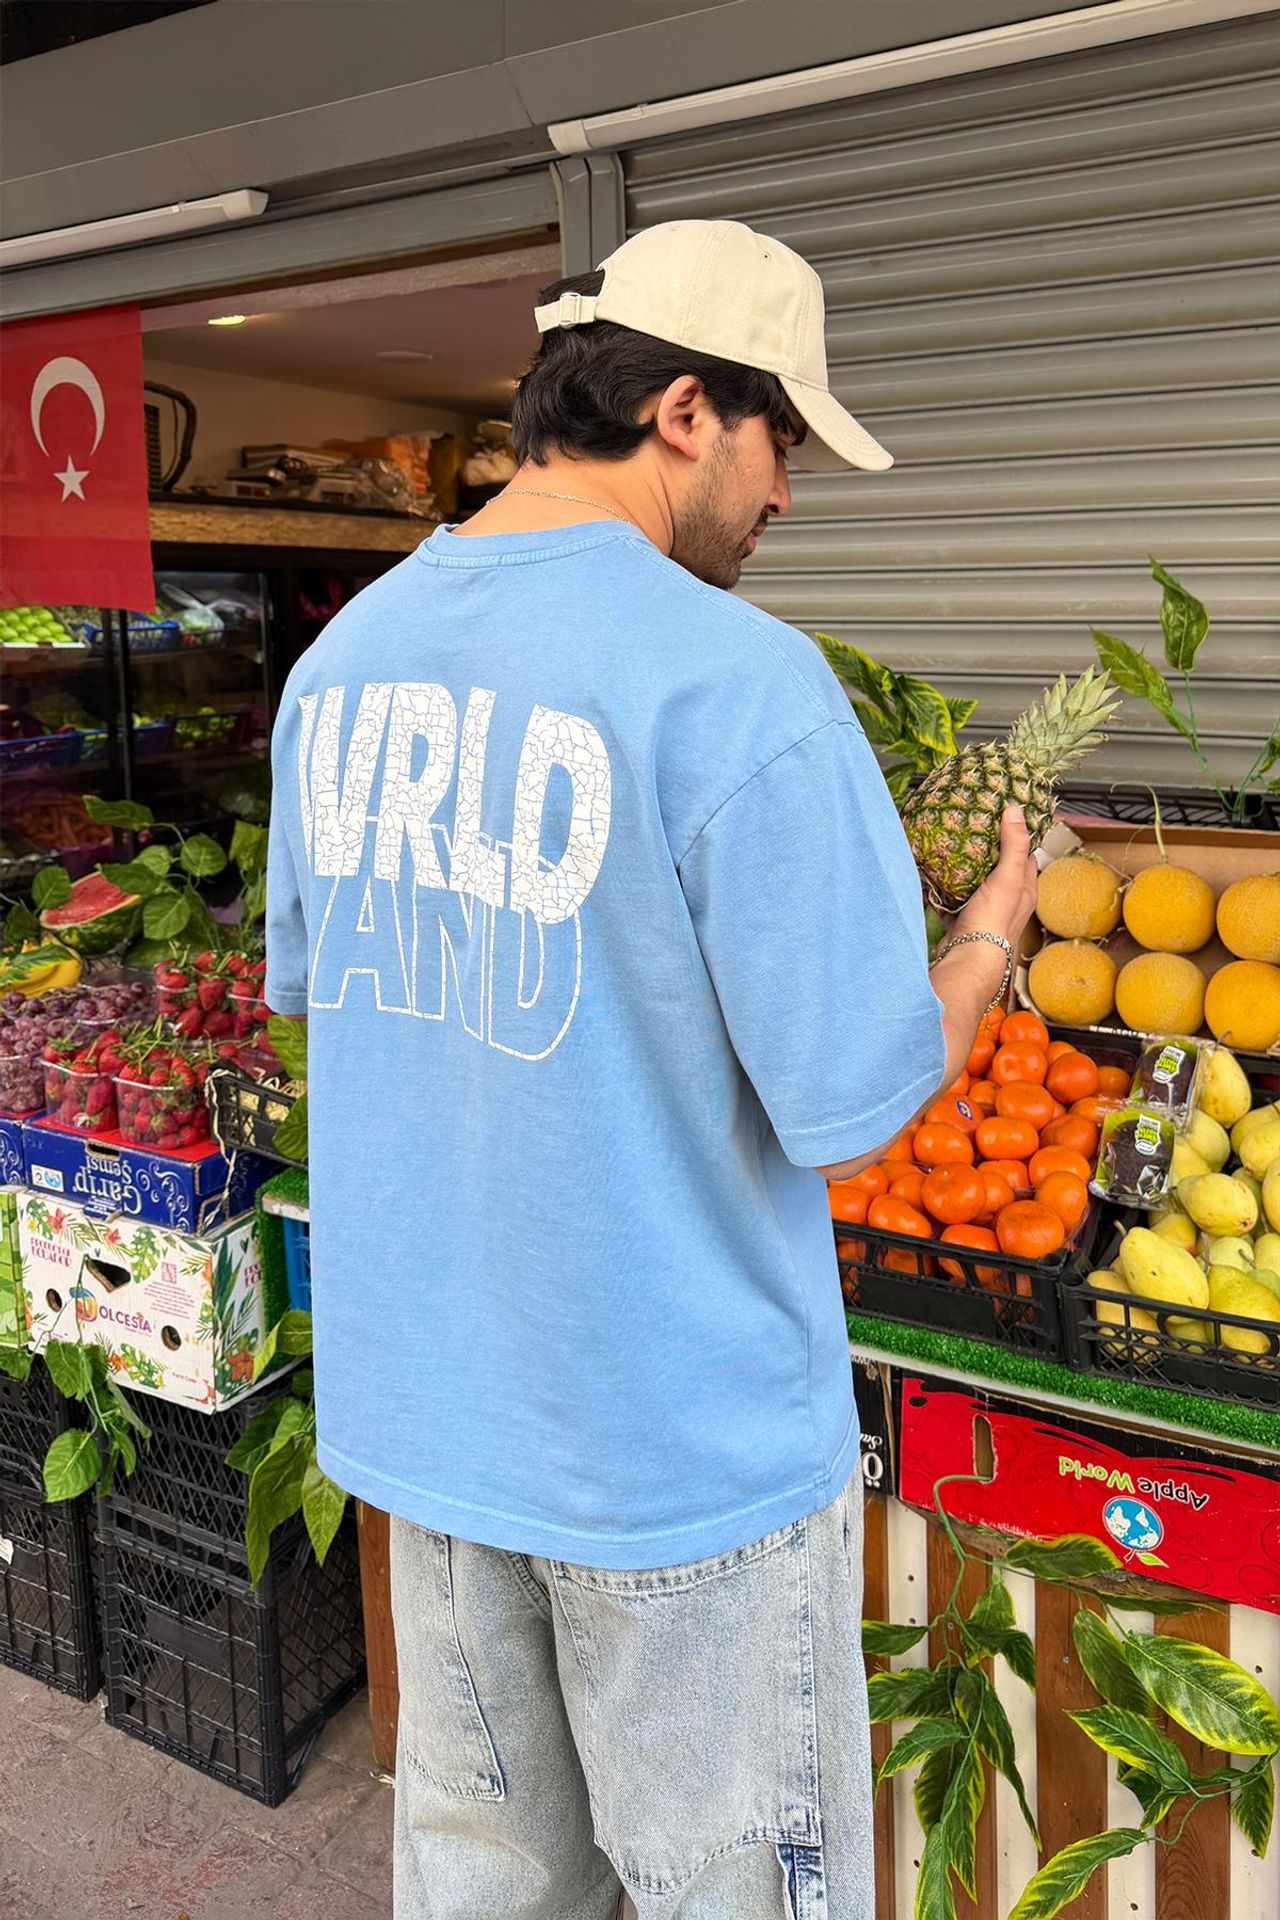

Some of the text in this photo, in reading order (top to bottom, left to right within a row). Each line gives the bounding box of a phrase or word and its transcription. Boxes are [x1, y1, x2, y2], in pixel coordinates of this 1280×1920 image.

[297, 682, 612, 925] WRLD
[74, 1165, 142, 1215] Garip
[86, 1156, 132, 1183] Şemsi
[861, 1452, 883, 1488] Ö
[1057, 1455, 1210, 1512] Apple World
